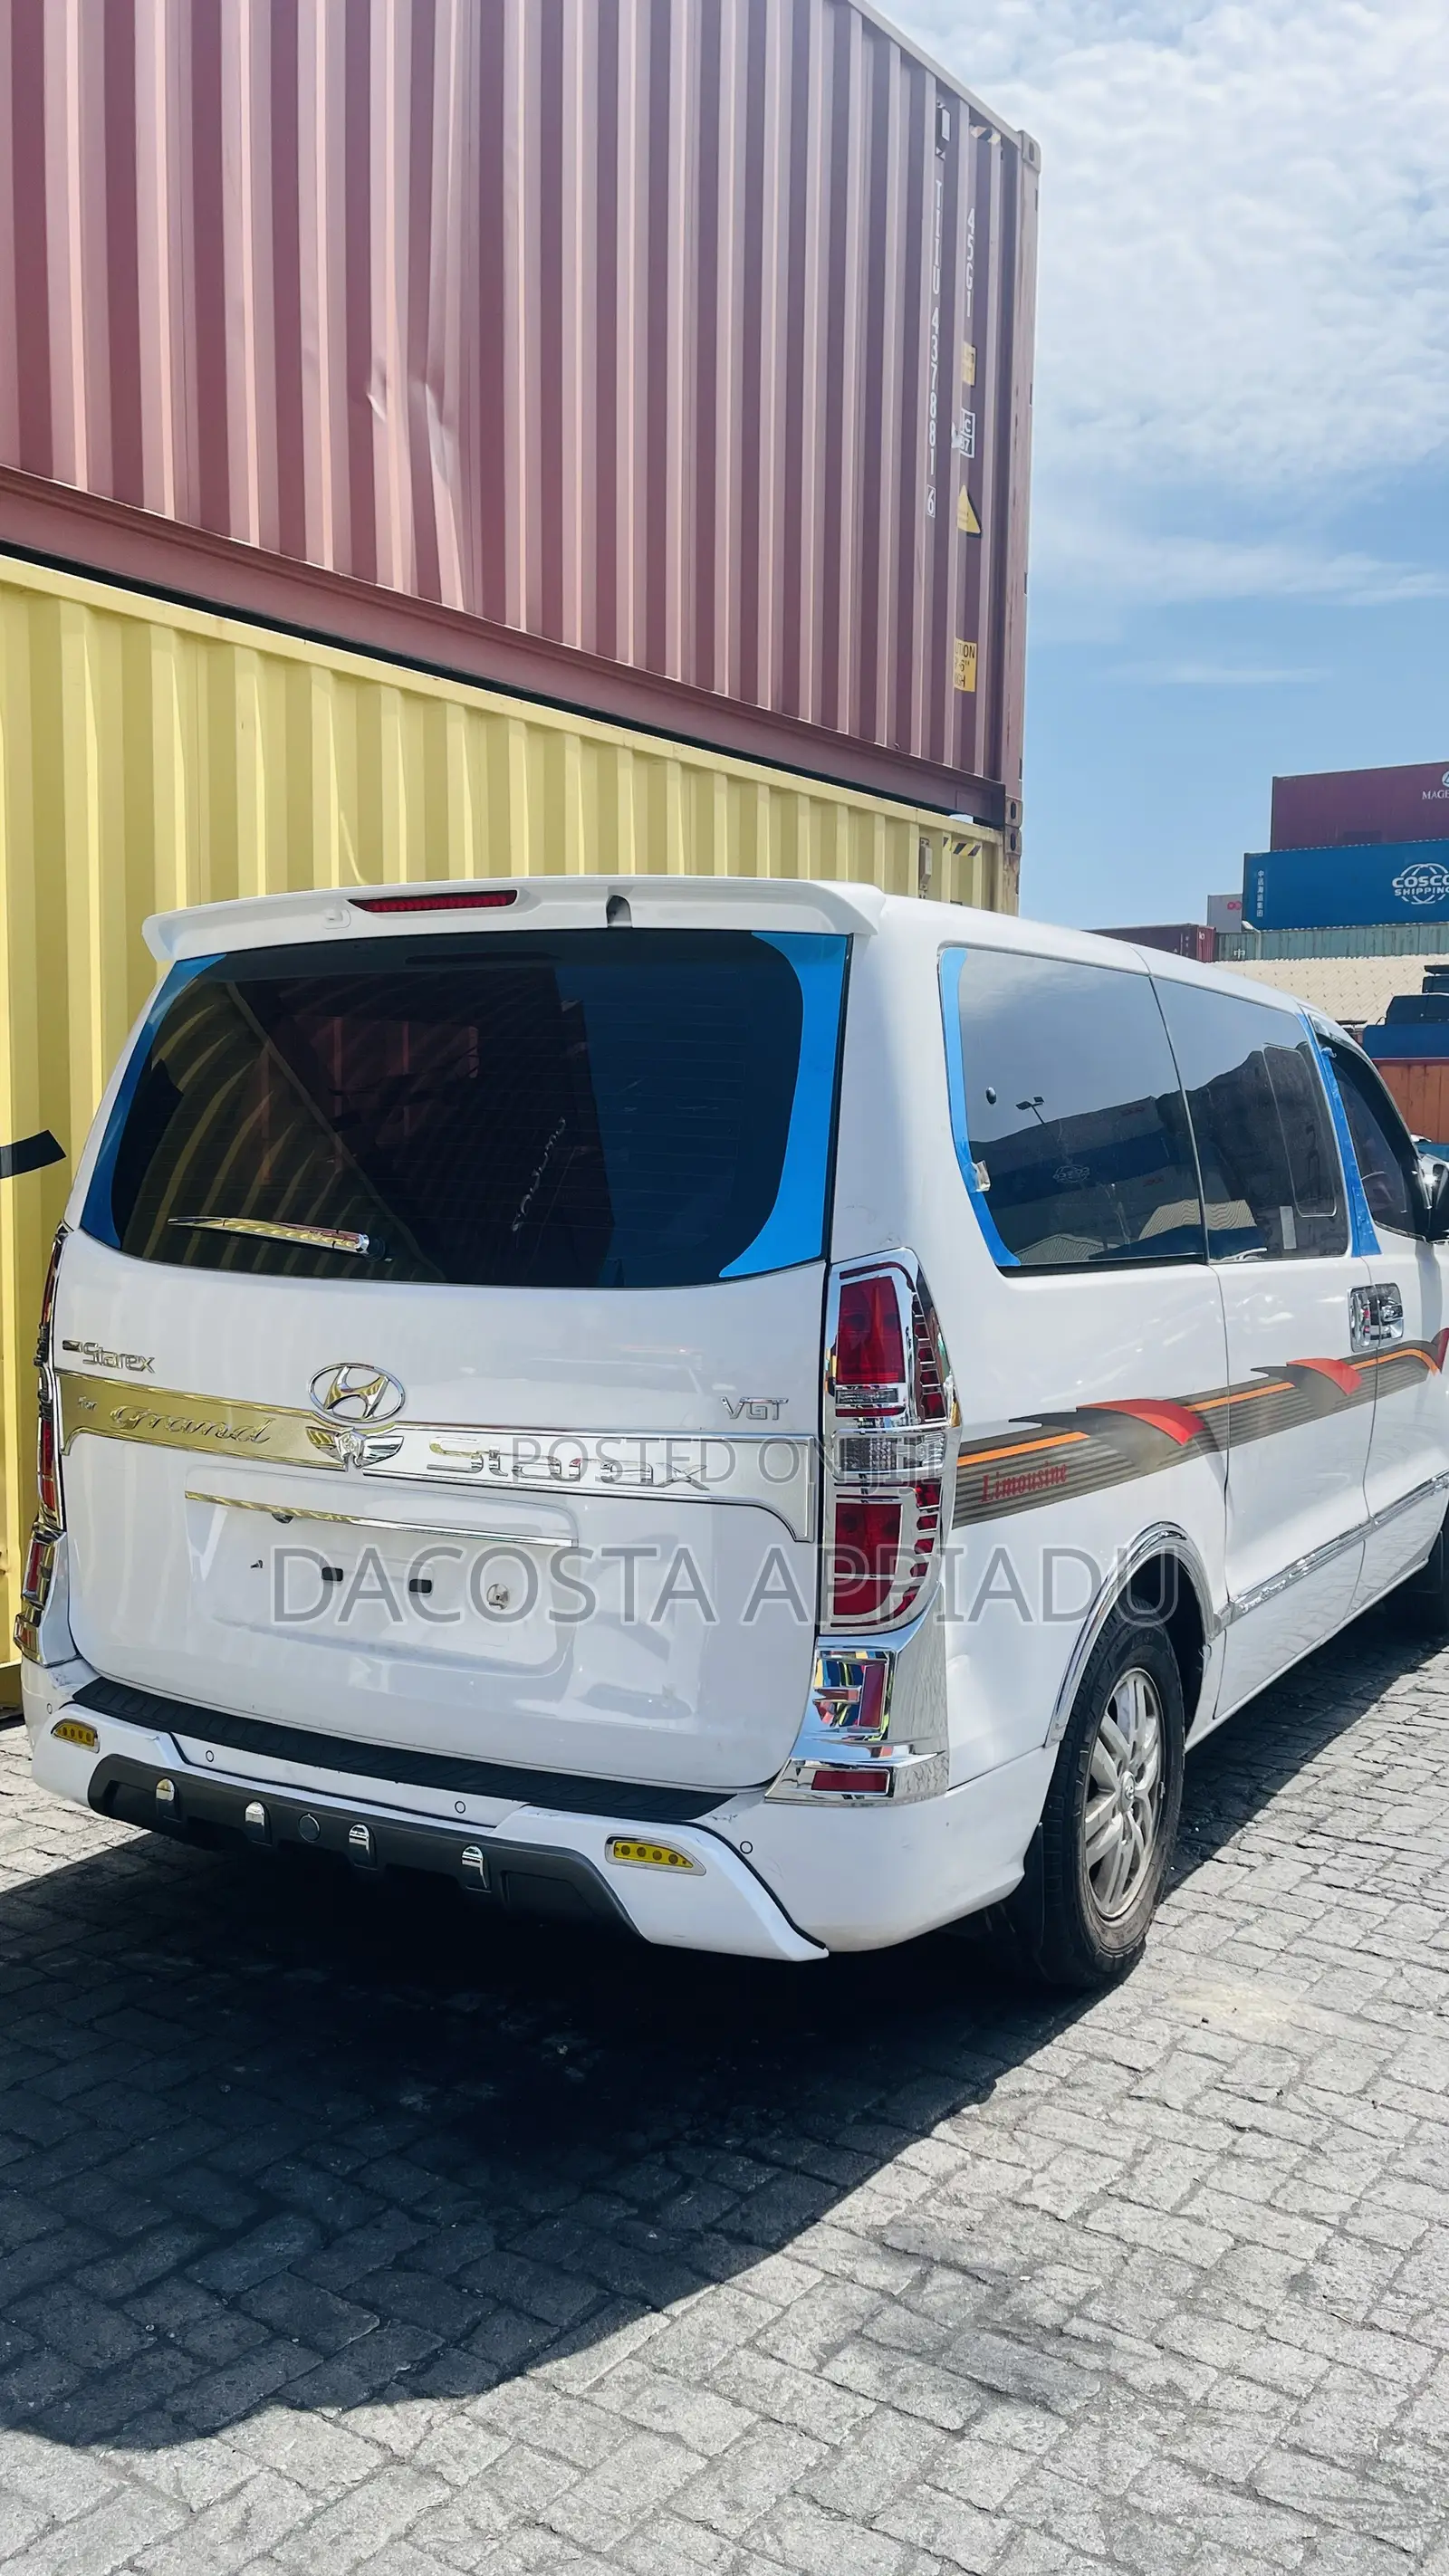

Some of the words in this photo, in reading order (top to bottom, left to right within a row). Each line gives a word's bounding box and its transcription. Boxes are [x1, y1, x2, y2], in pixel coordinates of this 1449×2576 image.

[966, 207, 975, 317] 45G1
[929, 306, 939, 475] 437881
[82, 1342, 156, 1374] Starex
[719, 1395, 789, 1421] VGT
[979, 1460, 1068, 1503] Limousine
